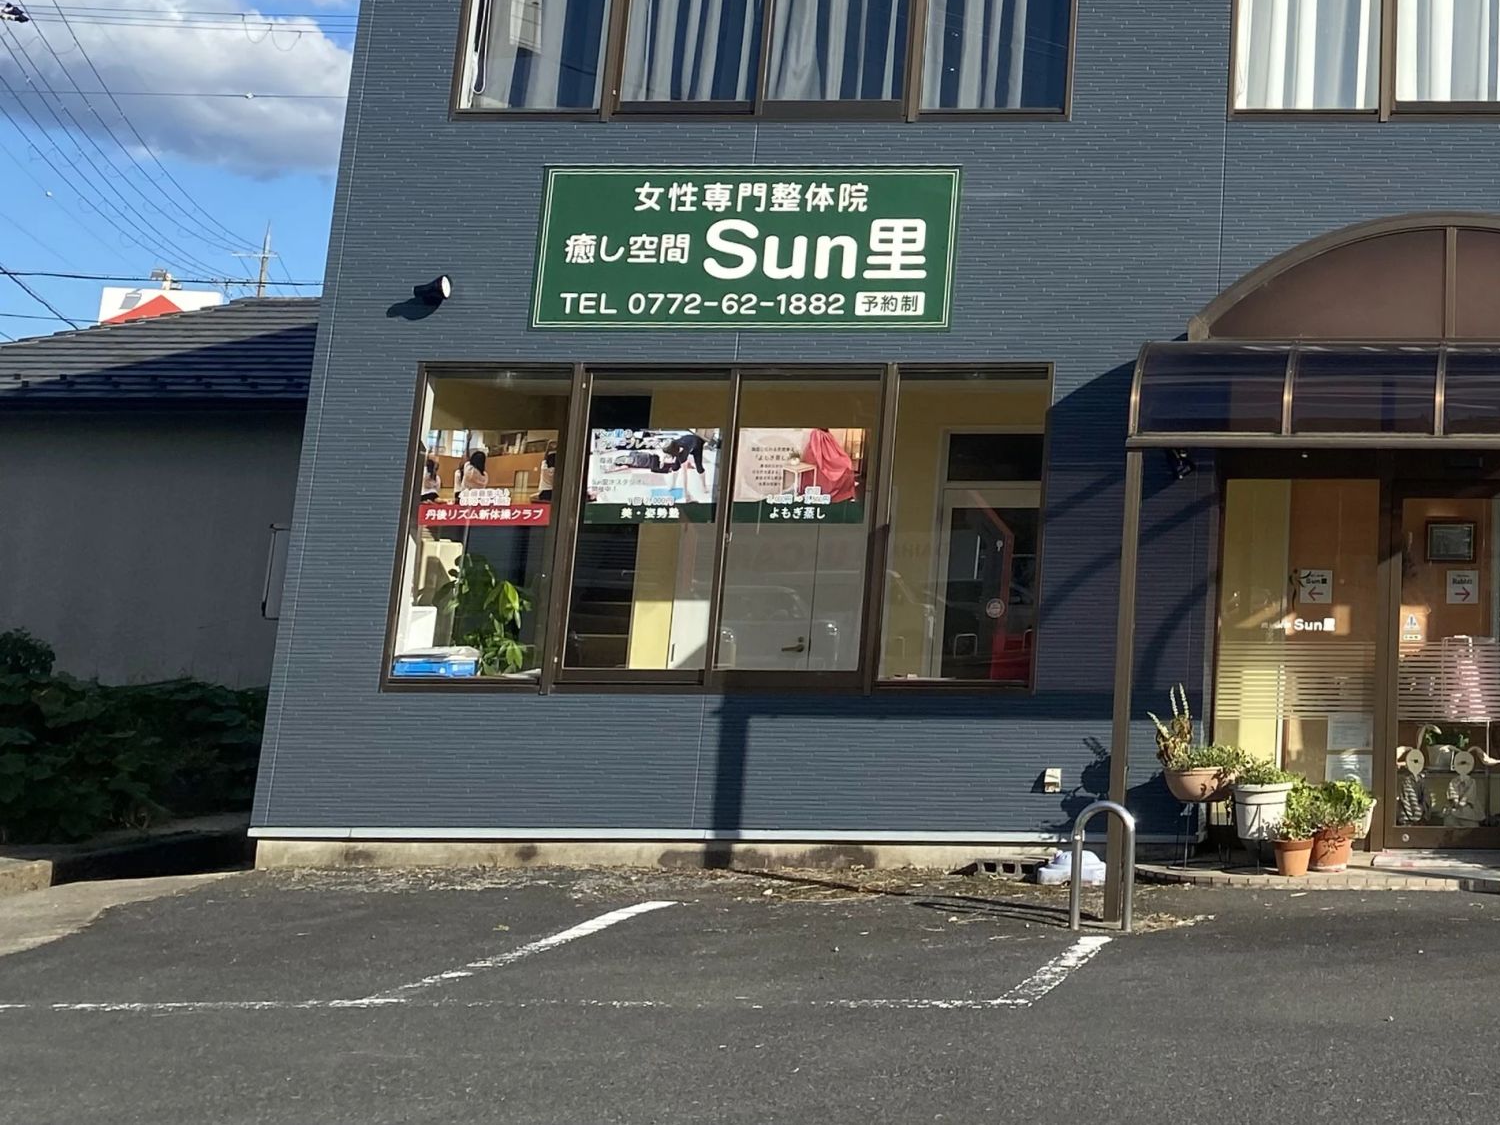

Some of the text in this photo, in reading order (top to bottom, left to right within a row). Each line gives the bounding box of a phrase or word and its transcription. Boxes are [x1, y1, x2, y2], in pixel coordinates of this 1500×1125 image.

[634, 181, 869, 213] 女性専門整体院
[564, 218, 927, 280] 癒し空間 Sun里
[559, 292, 919, 315] TEL 0772-62-1882 予約制
[425, 509, 544, 521] 丹後リズム新体操クラブ
[769, 507, 826, 519] よもぎ蒸し
